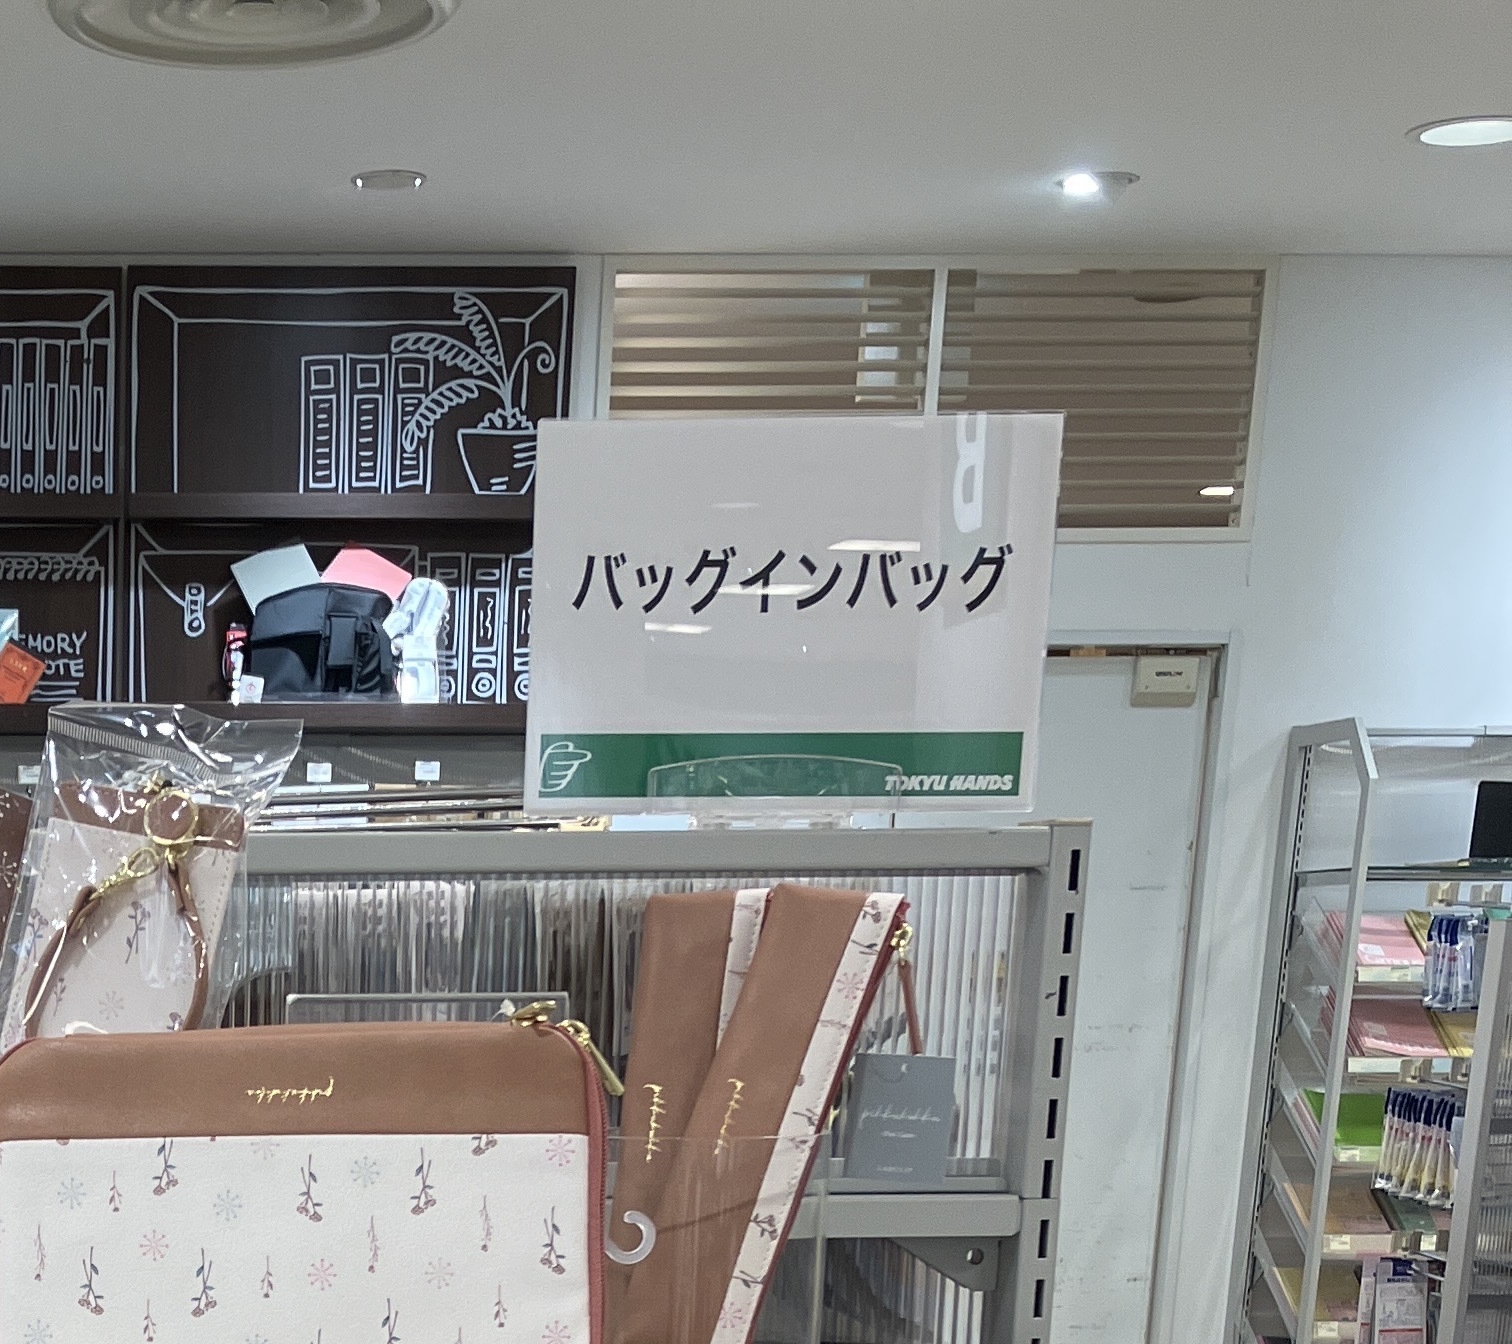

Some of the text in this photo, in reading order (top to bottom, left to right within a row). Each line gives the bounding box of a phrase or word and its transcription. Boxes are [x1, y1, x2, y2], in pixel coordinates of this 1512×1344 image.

[572, 543, 1014, 614] バッグインバッグ
[884, 775, 1014, 791] TOKYU HANDS
